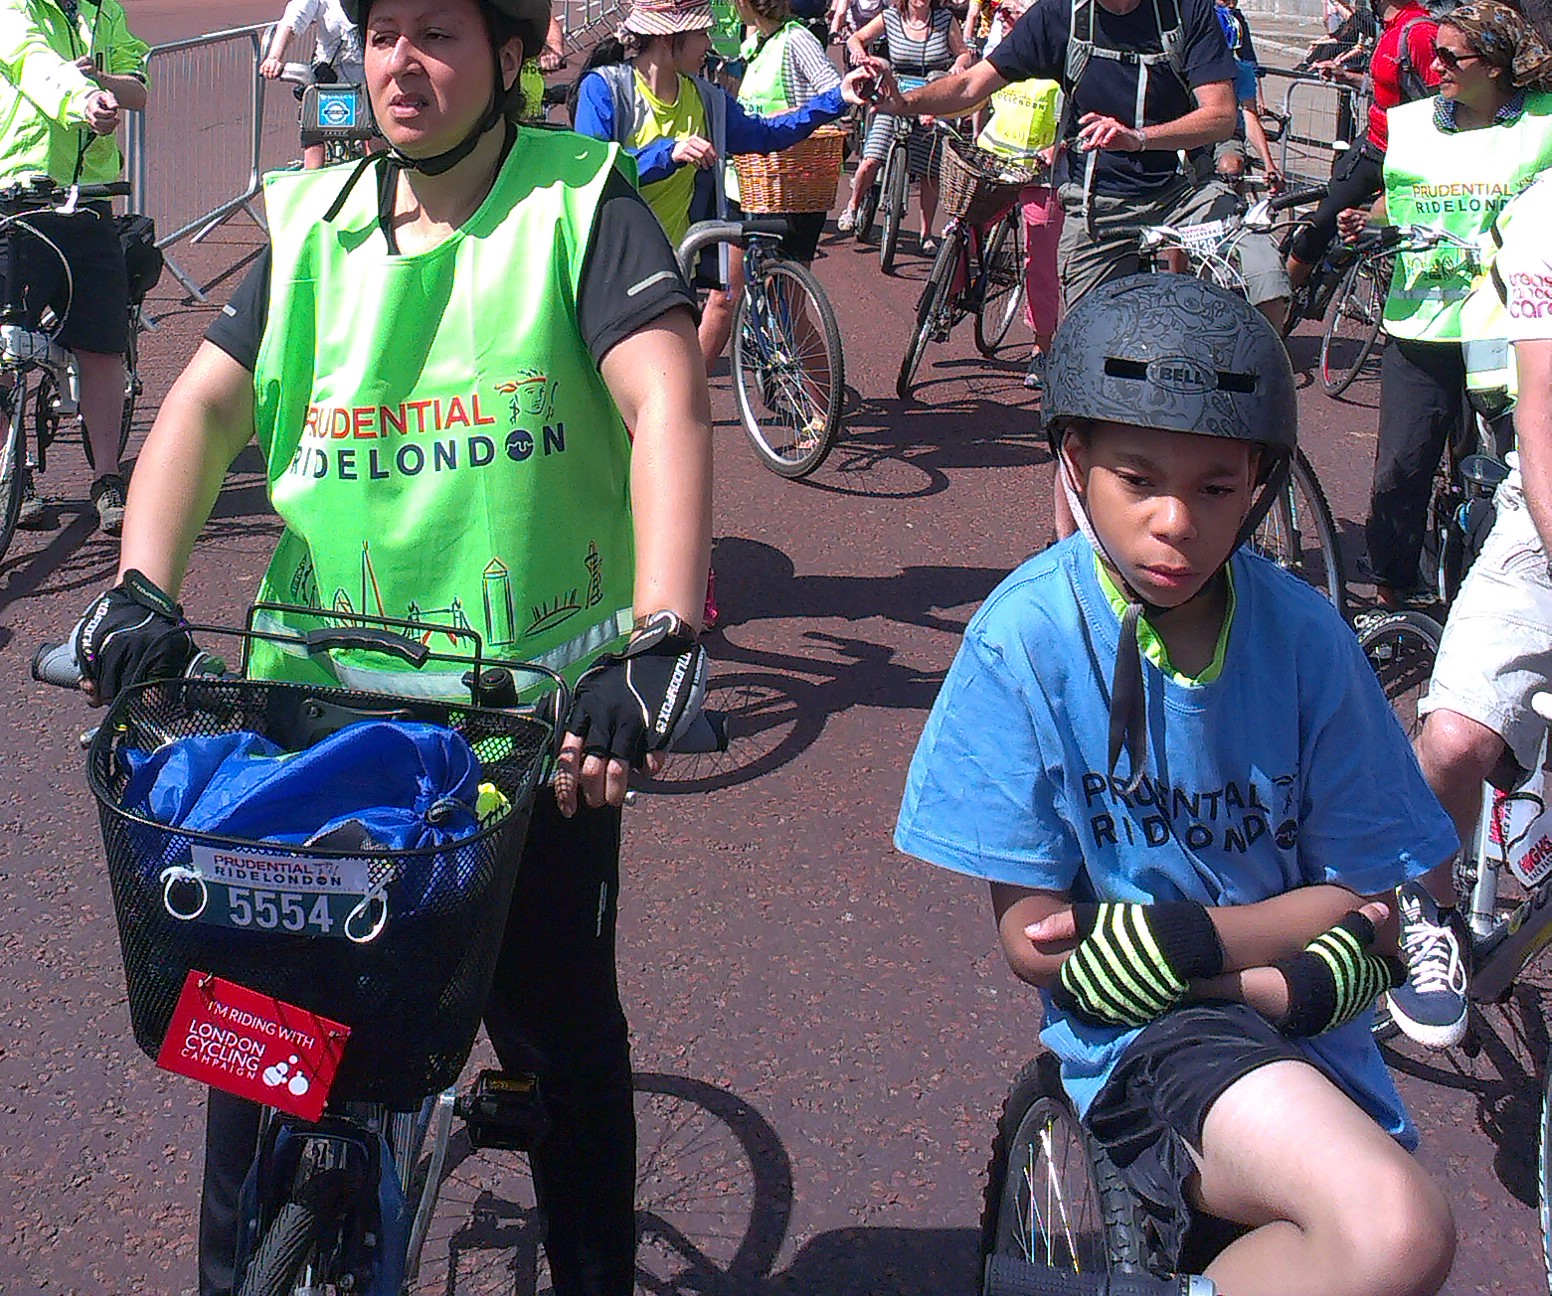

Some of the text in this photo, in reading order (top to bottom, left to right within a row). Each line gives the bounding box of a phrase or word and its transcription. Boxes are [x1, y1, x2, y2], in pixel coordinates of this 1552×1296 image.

[1412, 183, 1514, 198] PRUDENTIAL
[1160, 367, 1204, 384] BELL
[213, 854, 314, 875] PRUDENTIAL
[214, 865, 342, 886] RIDELONDON
[228, 886, 334, 934] 5554
[189, 1019, 266, 1055] LONDON
[207, 1001, 315, 1050] I'M RIDING WITH
[181, 1048, 256, 1081] CAMPAIGN
[185, 1035, 261, 1072] CYCLING
